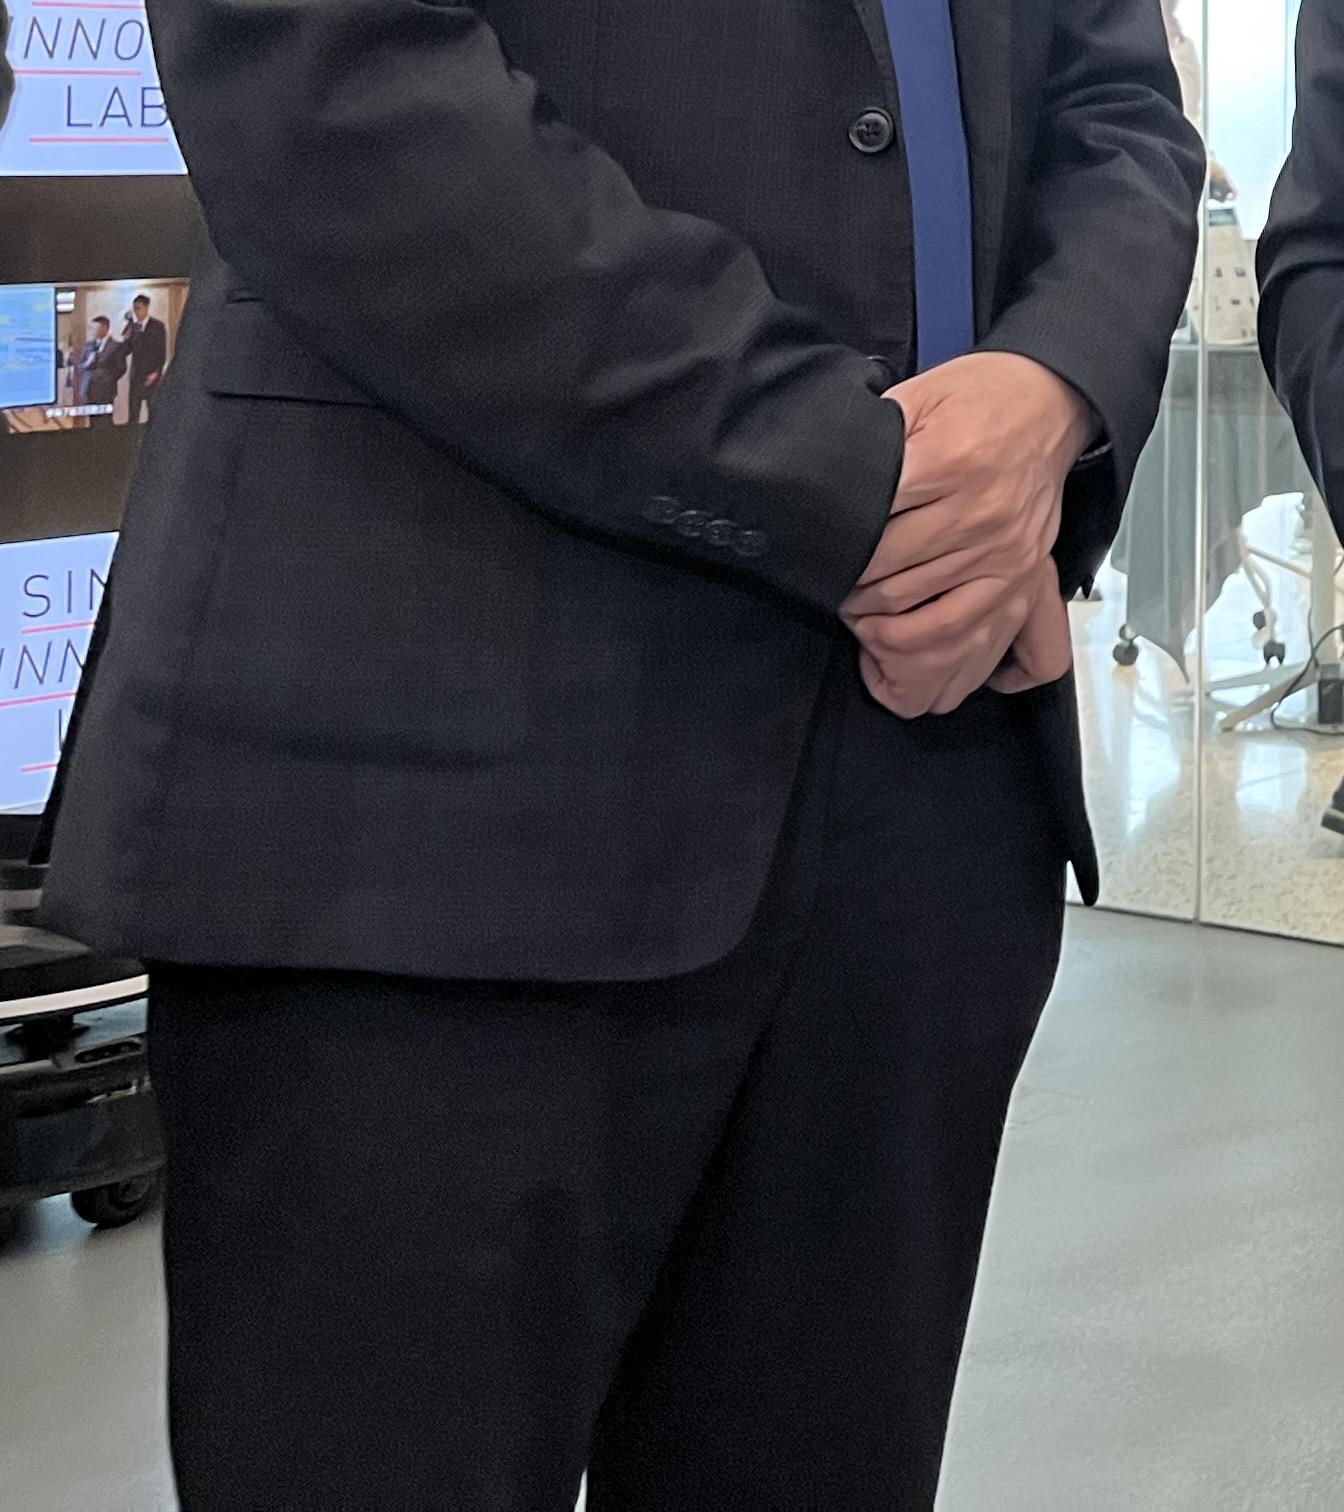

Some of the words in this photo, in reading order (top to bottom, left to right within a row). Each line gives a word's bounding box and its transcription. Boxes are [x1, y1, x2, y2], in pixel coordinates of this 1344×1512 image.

[10, 16, 144, 61] NNO
[66, 85, 169, 127] LAB
[22, 568, 106, 618] SIN
